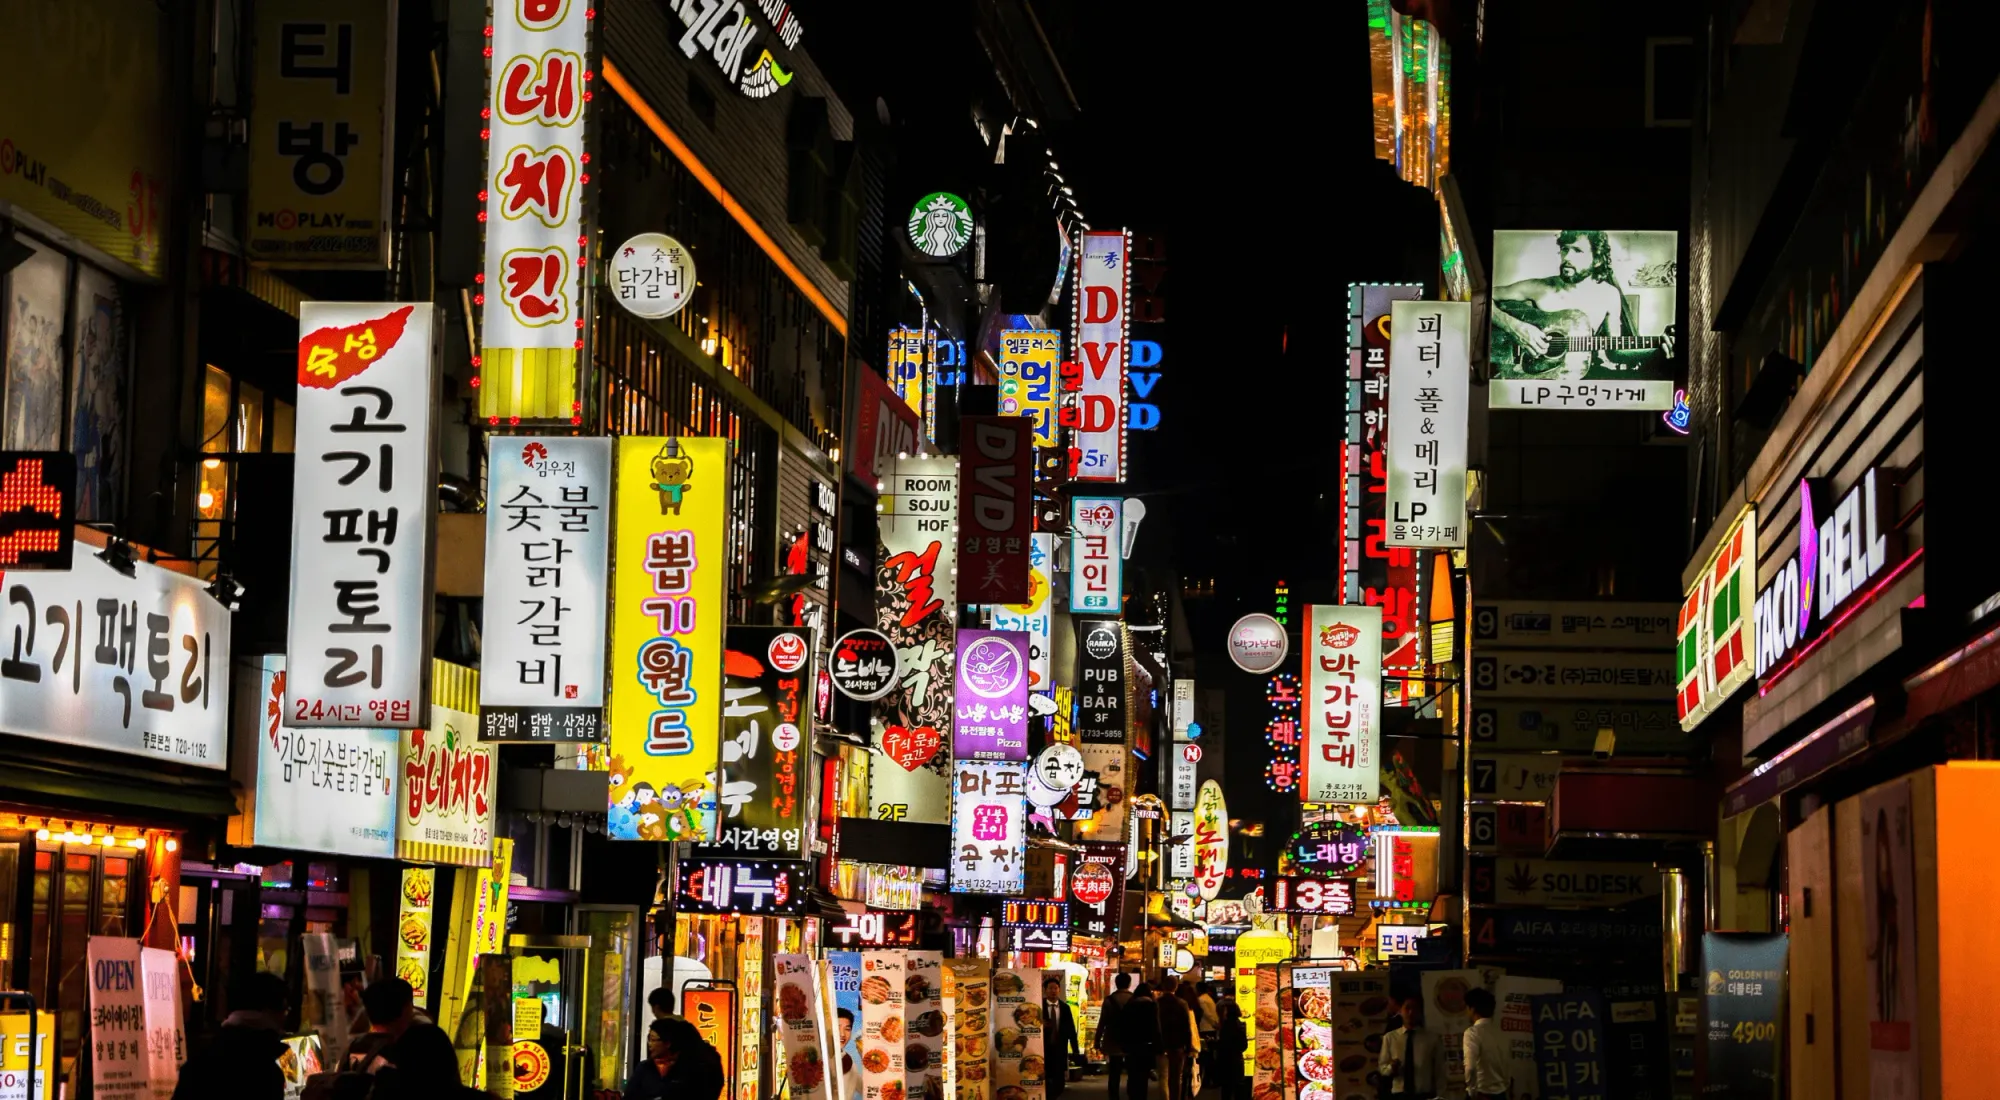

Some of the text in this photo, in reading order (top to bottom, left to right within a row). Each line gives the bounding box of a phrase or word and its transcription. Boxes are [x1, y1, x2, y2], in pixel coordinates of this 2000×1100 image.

[779, 11, 803, 51] HOF
[652, 247, 683, 263] 숯불
[1103, 251, 1120, 269] 秀
[618, 265, 684, 299] 닭갈비
[306, 327, 378, 379] 숙성
[1005, 338, 1057, 355] 엠플러스
[1081, 286, 1118, 433] DVD
[1128, 340, 1163, 430] DVD
[1364, 348, 1389, 432] 프라하
[1520, 385, 1646, 407] LP 구멍가게
[1414, 387, 1444, 414] 폴
[1420, 417, 1436, 435] &
[535, 460, 577, 479] 김우진
[1085, 449, 1109, 467] 5F
[1413, 439, 1440, 496] 메리
[905, 479, 951, 492] ROOM
[973, 421, 1020, 532] DVD
[499, 484, 600, 534] 숯불
[908, 499, 950, 512] SOJU
[1393, 501, 1428, 523] LP
[917, 519, 950, 532] HOF
[1392, 525, 1458, 541] 음악카페
[321, 386, 408, 690] 고기팩토리
[964, 537, 1021, 555] 상영관
[1818, 466, 1887, 621] BELL
[979, 557, 1008, 591] 美
[1082, 534, 1110, 592] 코인
[1087, 597, 1105, 607] 3F
[515, 537, 574, 698] 닭갈비
[1476, 608, 1496, 635] 9
[1753, 557, 1799, 680] TACO
[643, 533, 696, 754] 뽑기월드
[1233, 639, 1282, 650] 박가부대
[1084, 668, 1118, 682] PUB
[1476, 661, 1495, 686] 8
[1096, 684, 1105, 694] &
[295, 699, 412, 722] 24시간 영업
[1083, 695, 1118, 709] BAR
[1319, 653, 1361, 769] 박가부대
[486, 711, 598, 737] 닭갈비 닭발 삼겹살
[1094, 712, 1109, 723] 3F
[1476, 713, 1495, 738] 8
[913, 732, 940, 748] 문화
[996, 727, 1005, 737] &
[996, 738, 1022, 748] Pizza
[1271, 681, 1297, 787] 노래방
[175, 736, 208, 760] 720-1192
[900, 749, 927, 767] 공간
[279, 731, 388, 798] 김우진숯불닭갈비
[1475, 764, 1494, 789] 7
[772, 750, 799, 819] 삼겹살
[959, 770, 1024, 796] 마포
[1318, 790, 1368, 800] 723-2112
[877, 803, 908, 821] 2F
[1474, 816, 1492, 841] 6
[958, 843, 1020, 873] 곱창
[1080, 853, 1117, 866] Luxury
[1195, 823, 1225, 889] 노래방
[1297, 843, 1359, 864] 노래방
[974, 879, 1019, 890] 732-1197
[1072, 880, 1111, 895] 羊肉串
[1474, 865, 1645, 895] 5 SOLDESK
[1296, 880, 1349, 913] 3층
[1006, 903, 1059, 924] DVD
[1476, 916, 1555, 949] 4 AIFA
[95, 959, 136, 991] OPEN
[146, 971, 175, 1002] OPEN
[1728, 969, 1761, 980] GOLDEN
[1539, 1000, 1597, 1023] AIFA
[1731, 1021, 1776, 1045] 4900
